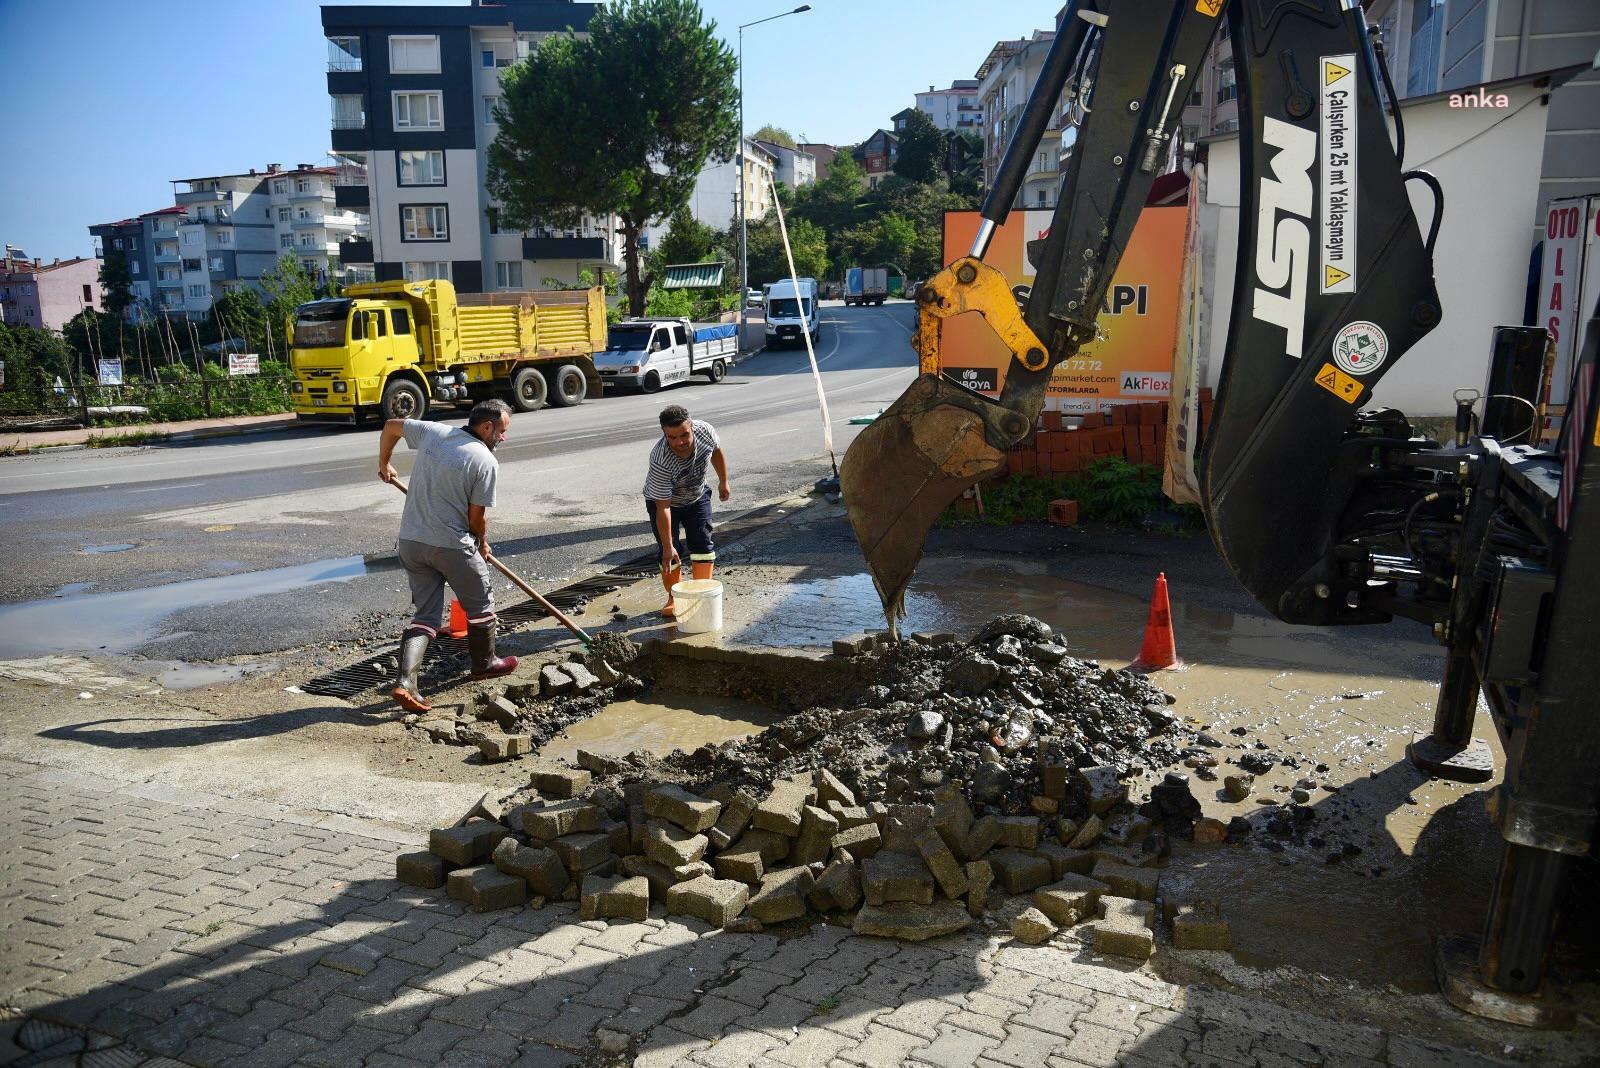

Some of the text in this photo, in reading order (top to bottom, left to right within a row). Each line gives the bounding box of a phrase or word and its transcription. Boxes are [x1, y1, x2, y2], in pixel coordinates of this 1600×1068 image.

[1325, 90, 1349, 261] Çalışırken 25 mt Yaklaşmayın
[1547, 206, 1580, 240] OTO
[1252, 115, 1317, 359] MST
[1072, 360, 1086, 370] 72
[1088, 360, 1103, 371] 72
[959, 380, 991, 390] BOYA
[1123, 377, 1169, 391] AkFlex
